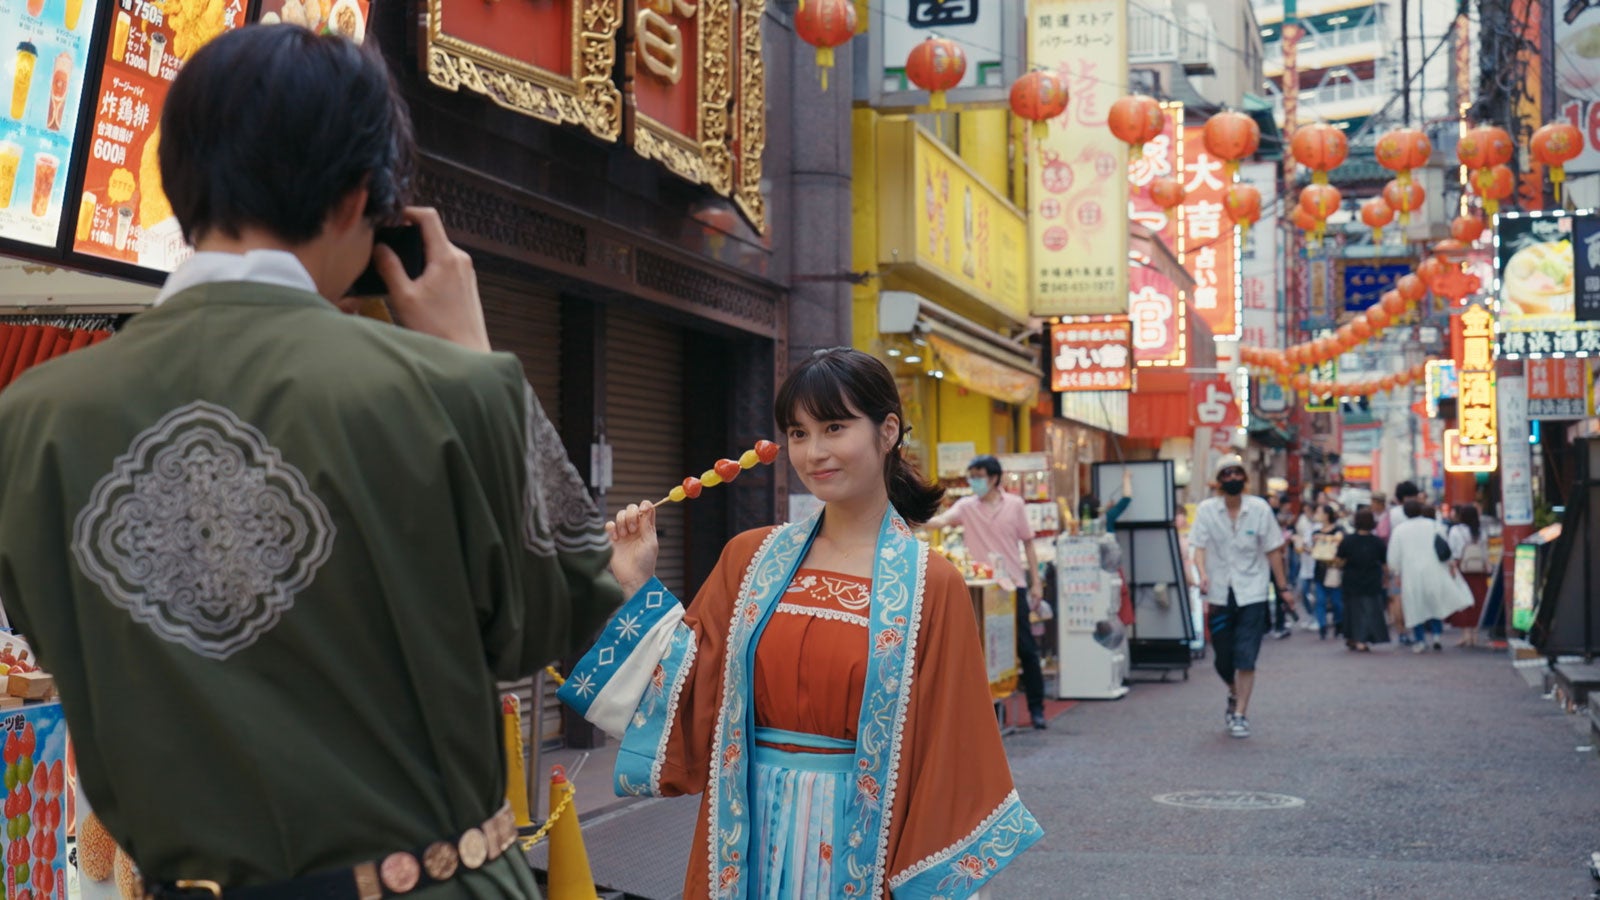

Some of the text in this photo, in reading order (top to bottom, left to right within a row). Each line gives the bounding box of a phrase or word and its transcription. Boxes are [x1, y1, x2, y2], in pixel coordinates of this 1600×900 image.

[100, 90, 150, 131] 炸鶏排
[93, 138, 127, 165] 600円
[1185, 154, 1223, 239] 大吉
